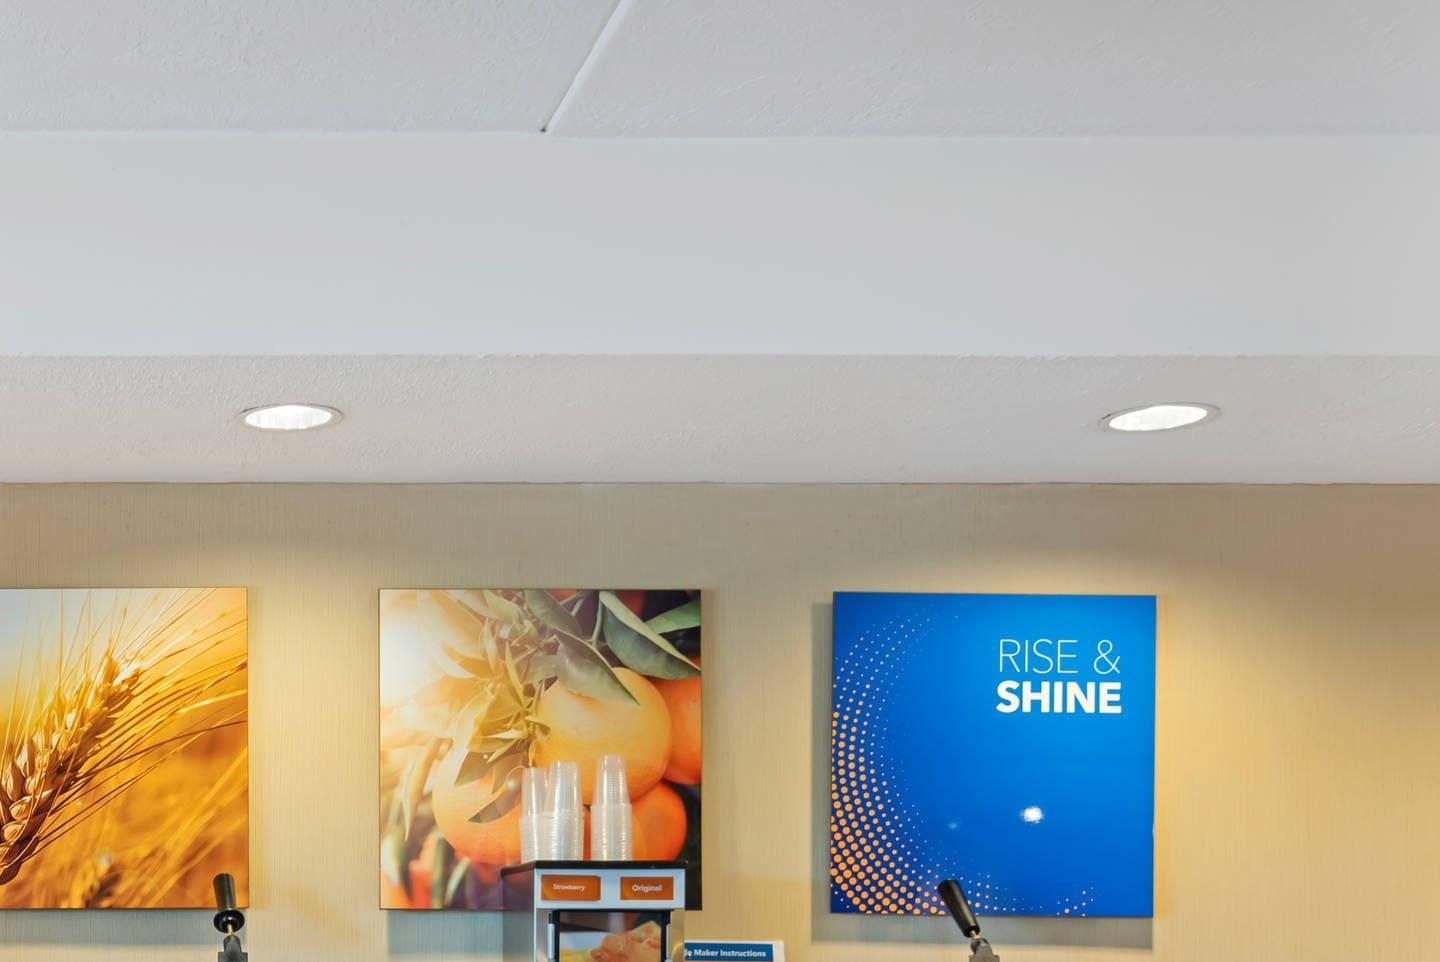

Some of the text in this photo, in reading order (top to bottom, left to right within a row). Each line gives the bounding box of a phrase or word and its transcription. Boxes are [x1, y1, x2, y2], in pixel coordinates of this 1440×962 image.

[999, 638, 1121, 675] RISE &
[996, 680, 1122, 714] SHINE
[631, 884, 663, 894] Original
[694, 949, 719, 957] Maker
[720, 949, 766, 958] Instructions
